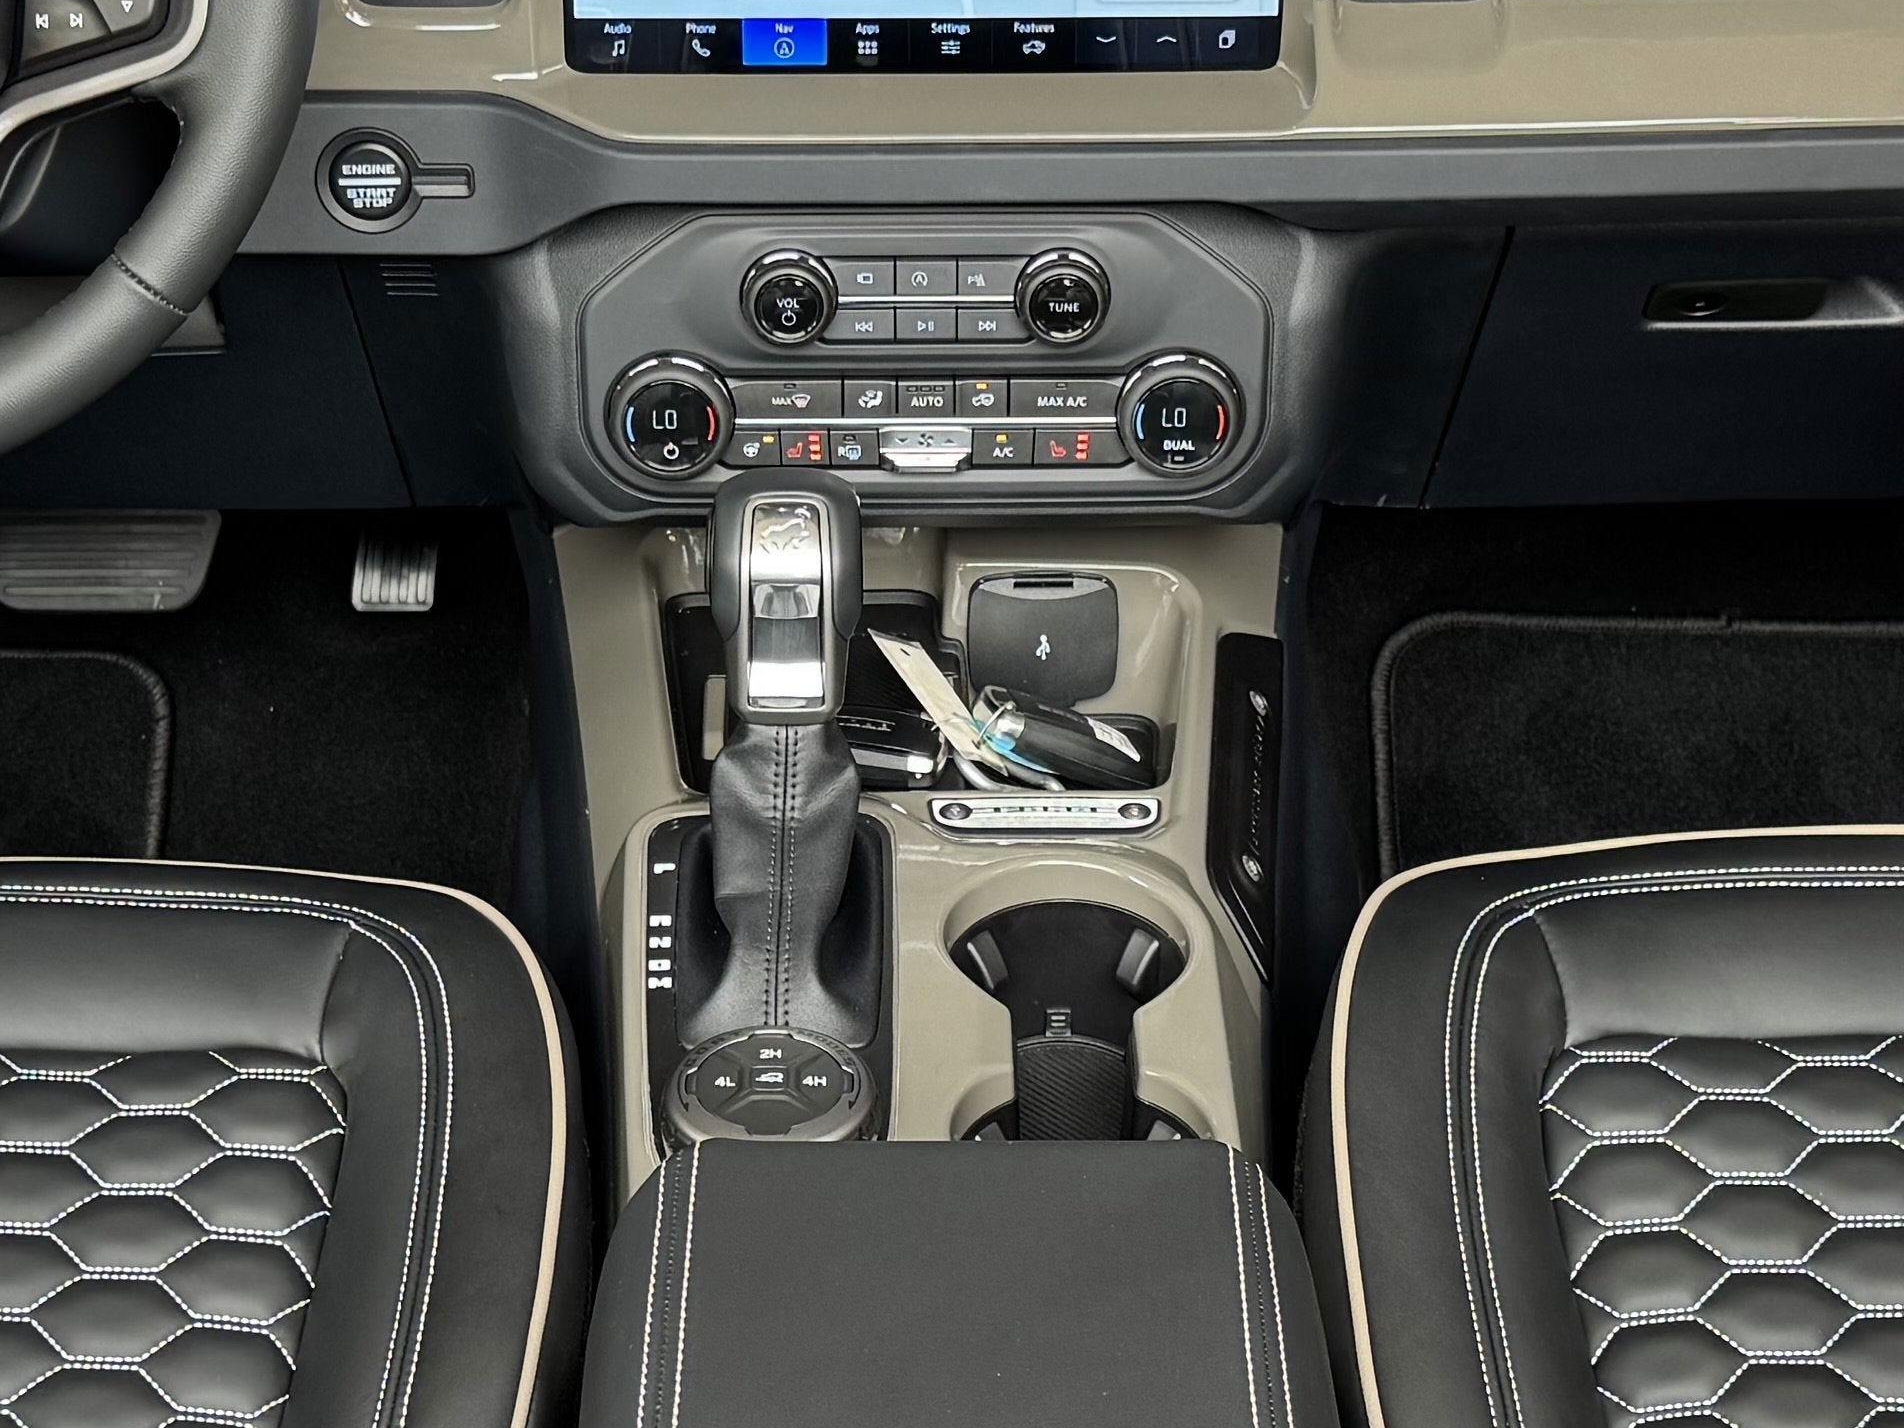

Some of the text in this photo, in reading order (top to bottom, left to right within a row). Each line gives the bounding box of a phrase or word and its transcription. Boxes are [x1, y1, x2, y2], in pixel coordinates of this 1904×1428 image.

[603, 23, 632, 35] Audio
[685, 22, 717, 35] Phone
[775, 23, 794, 35] Nav
[855, 23, 880, 36] Apps
[931, 22, 971, 36] Settings
[1013, 22, 1055, 34] Features
[342, 163, 396, 175] ENGINE
[346, 187, 396, 199] START
[352, 198, 393, 208] STOP
[776, 297, 800, 309] VOL
[1048, 302, 1080, 314] TUNE
[910, 396, 944, 408] AUTO
[1037, 396, 1087, 408] MAX A/C
[652, 409, 677, 430] LO
[1162, 407, 1187, 428] LO
[1163, 440, 1195, 451] DUAL
[992, 446, 1014, 459] A/C
[647, 976, 673, 989] M
[759, 1048, 782, 1059] 2H
[714, 1076, 736, 1087] 4L
[802, 1076, 827, 1087] 4H
